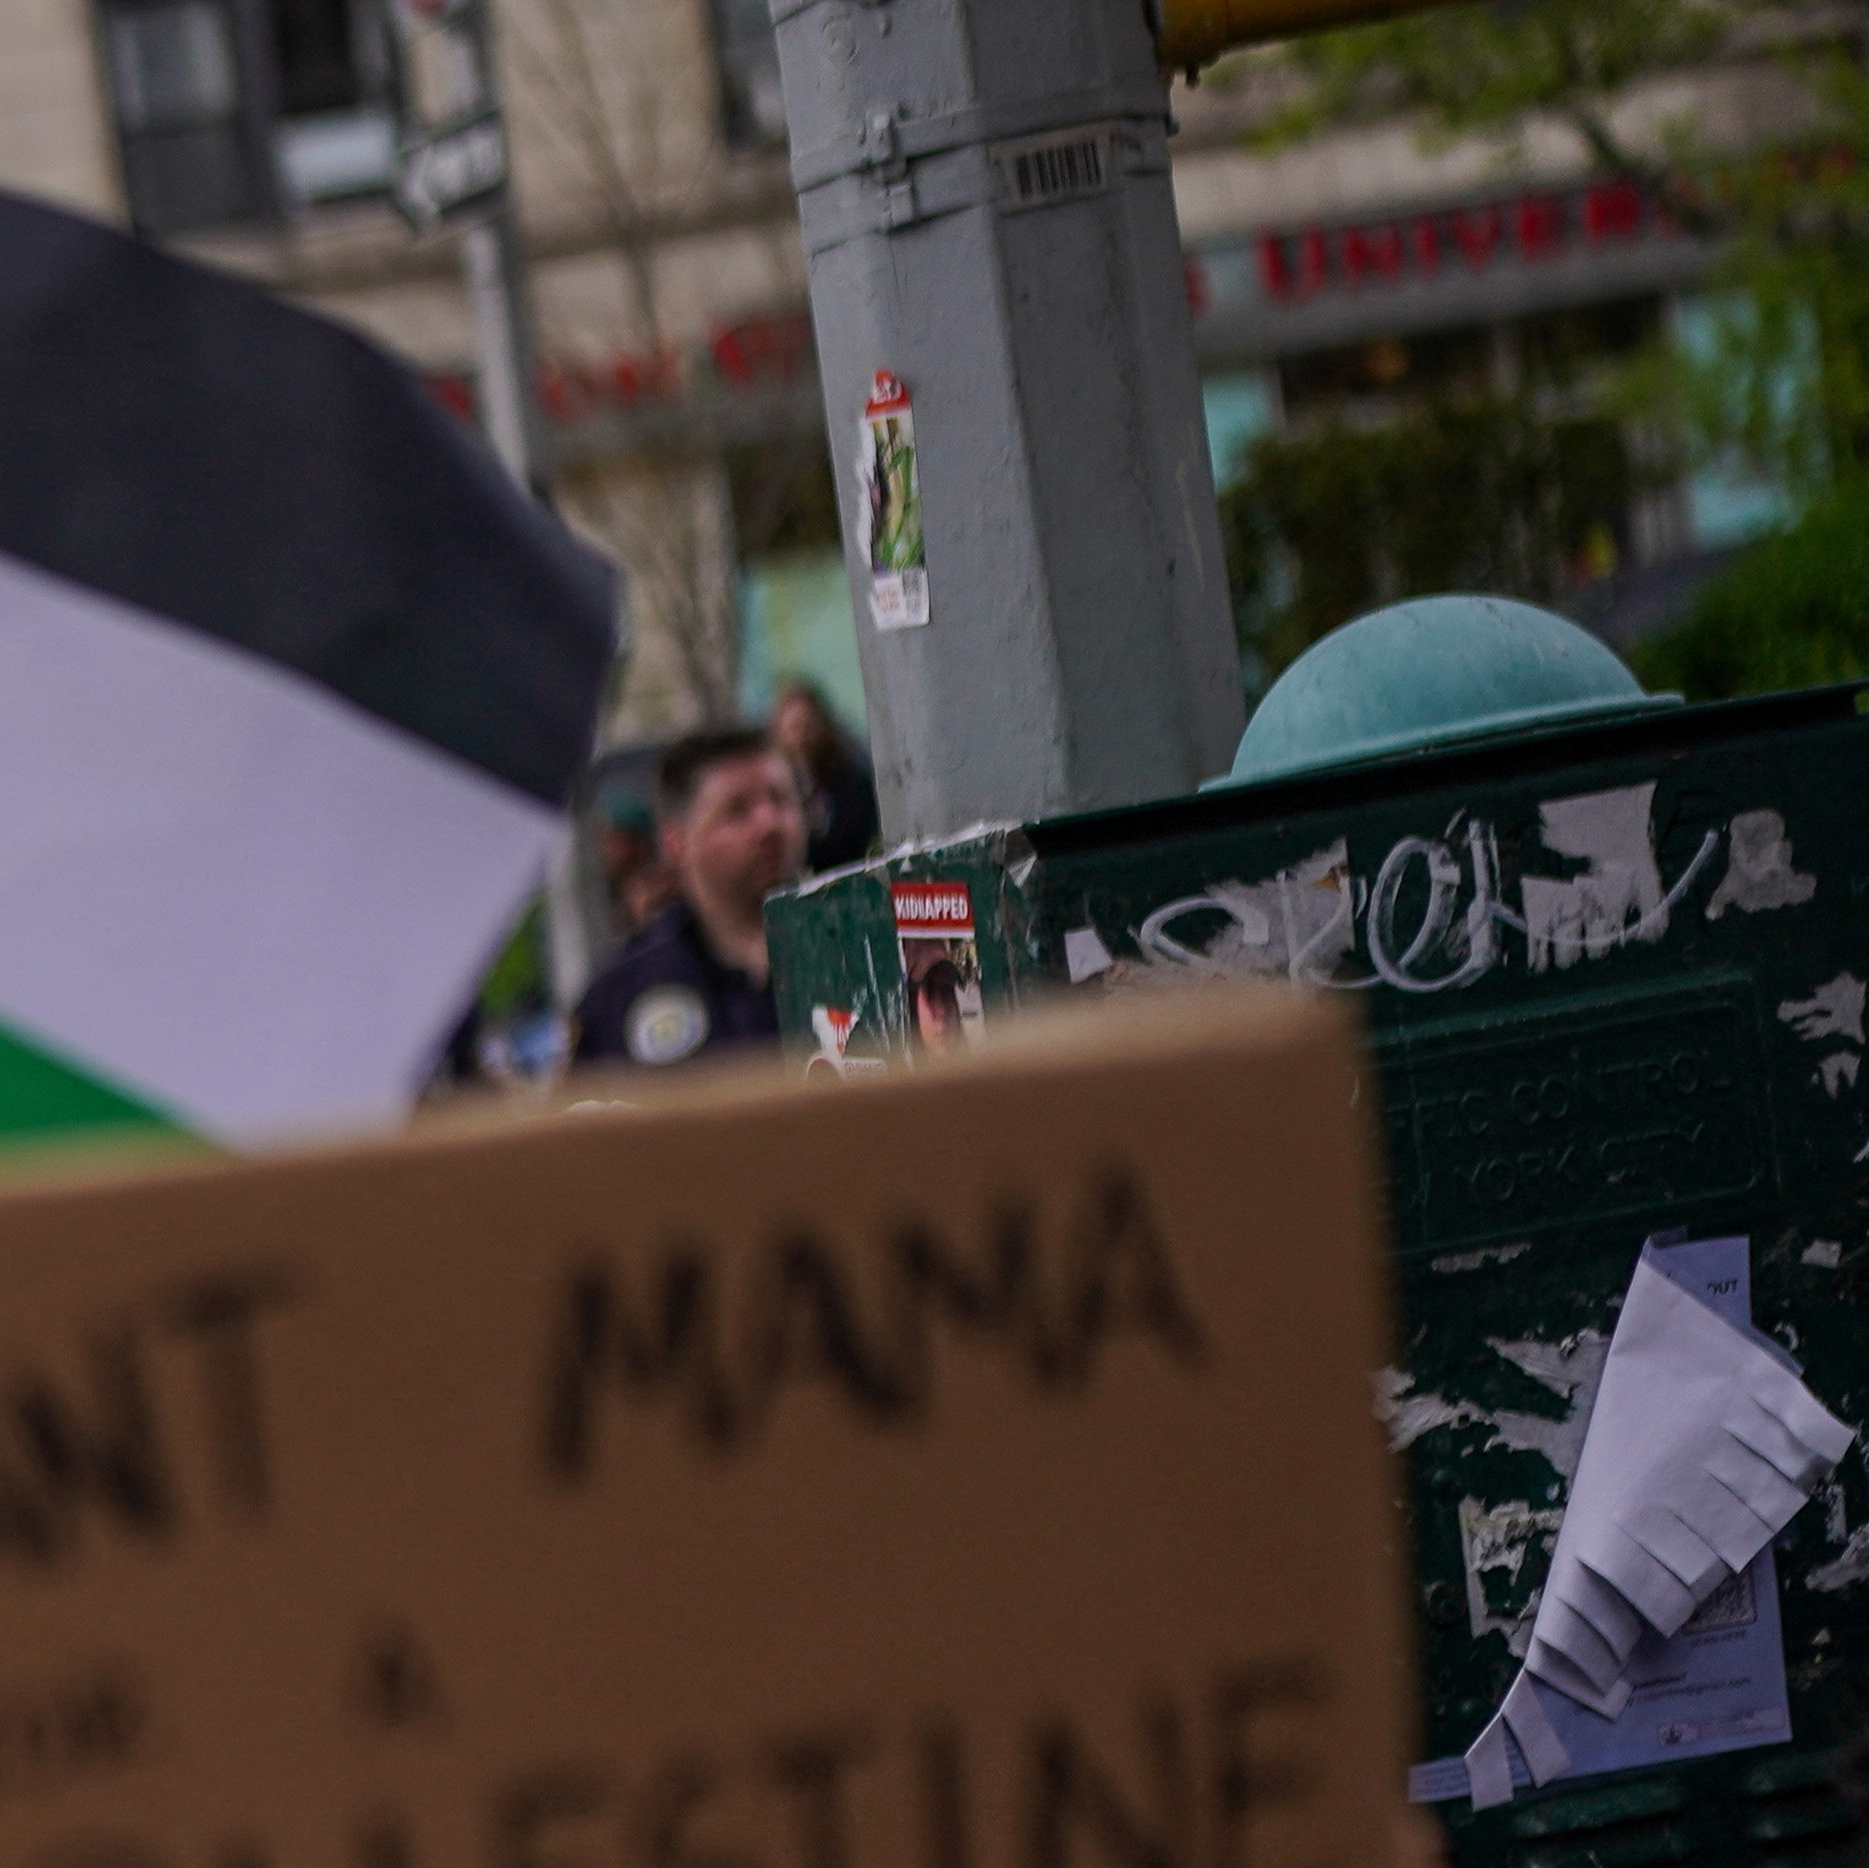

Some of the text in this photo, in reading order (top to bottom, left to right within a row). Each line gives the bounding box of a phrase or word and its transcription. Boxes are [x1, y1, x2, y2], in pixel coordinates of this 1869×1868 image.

[893, 892, 968, 921] KIDNAPPED
[543, 1168, 1207, 1485] MAMA
[341, 1615, 449, 1740] A
